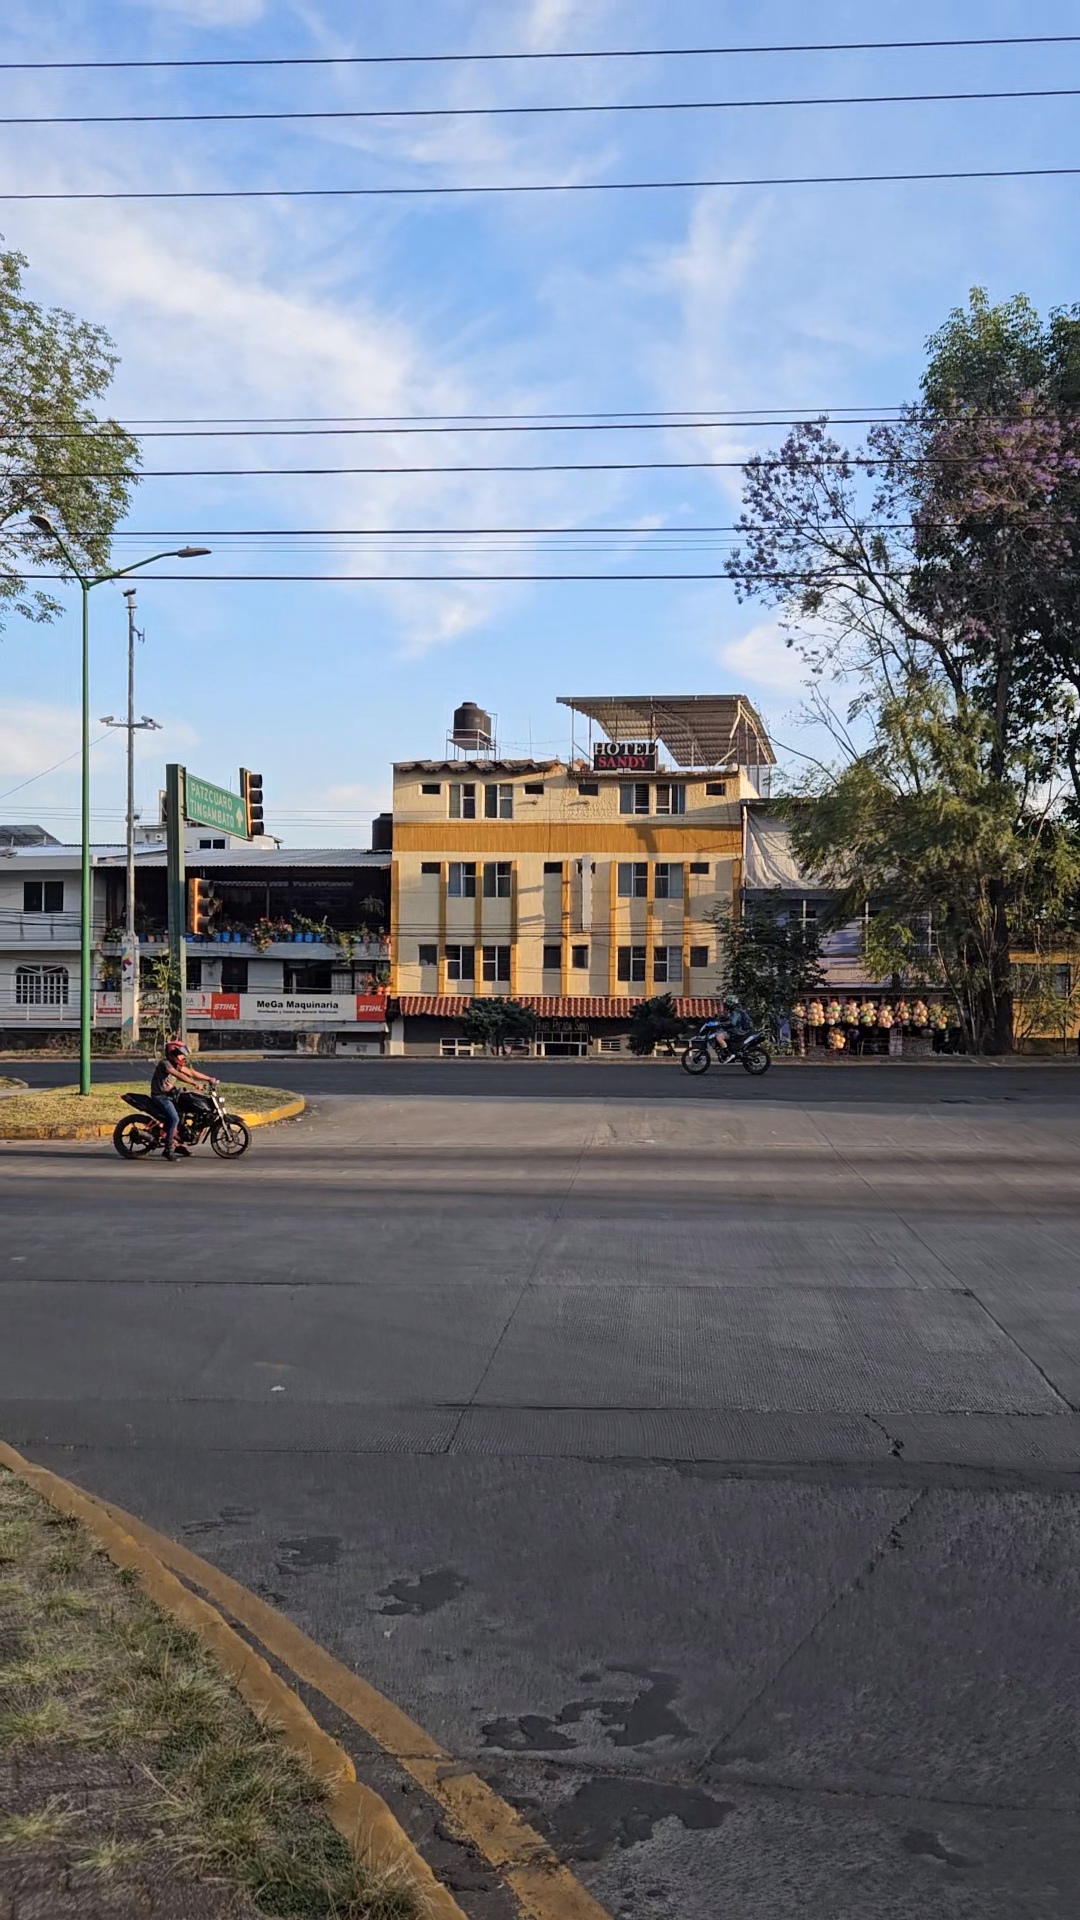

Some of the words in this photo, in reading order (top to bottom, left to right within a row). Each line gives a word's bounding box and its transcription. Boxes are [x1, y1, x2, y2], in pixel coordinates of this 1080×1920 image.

[594, 743, 655, 755] HOTEL
[598, 756, 648, 768] SANDY
[191, 782, 233, 811] PATZCUARO
[190, 799, 235, 828] TINGAMBATO
[213, 1003, 238, 1011] STIHL
[256, 1000, 284, 1008] MeGa
[286, 1000, 339, 1010] Maquinaria
[358, 1004, 383, 1012] STIHL
